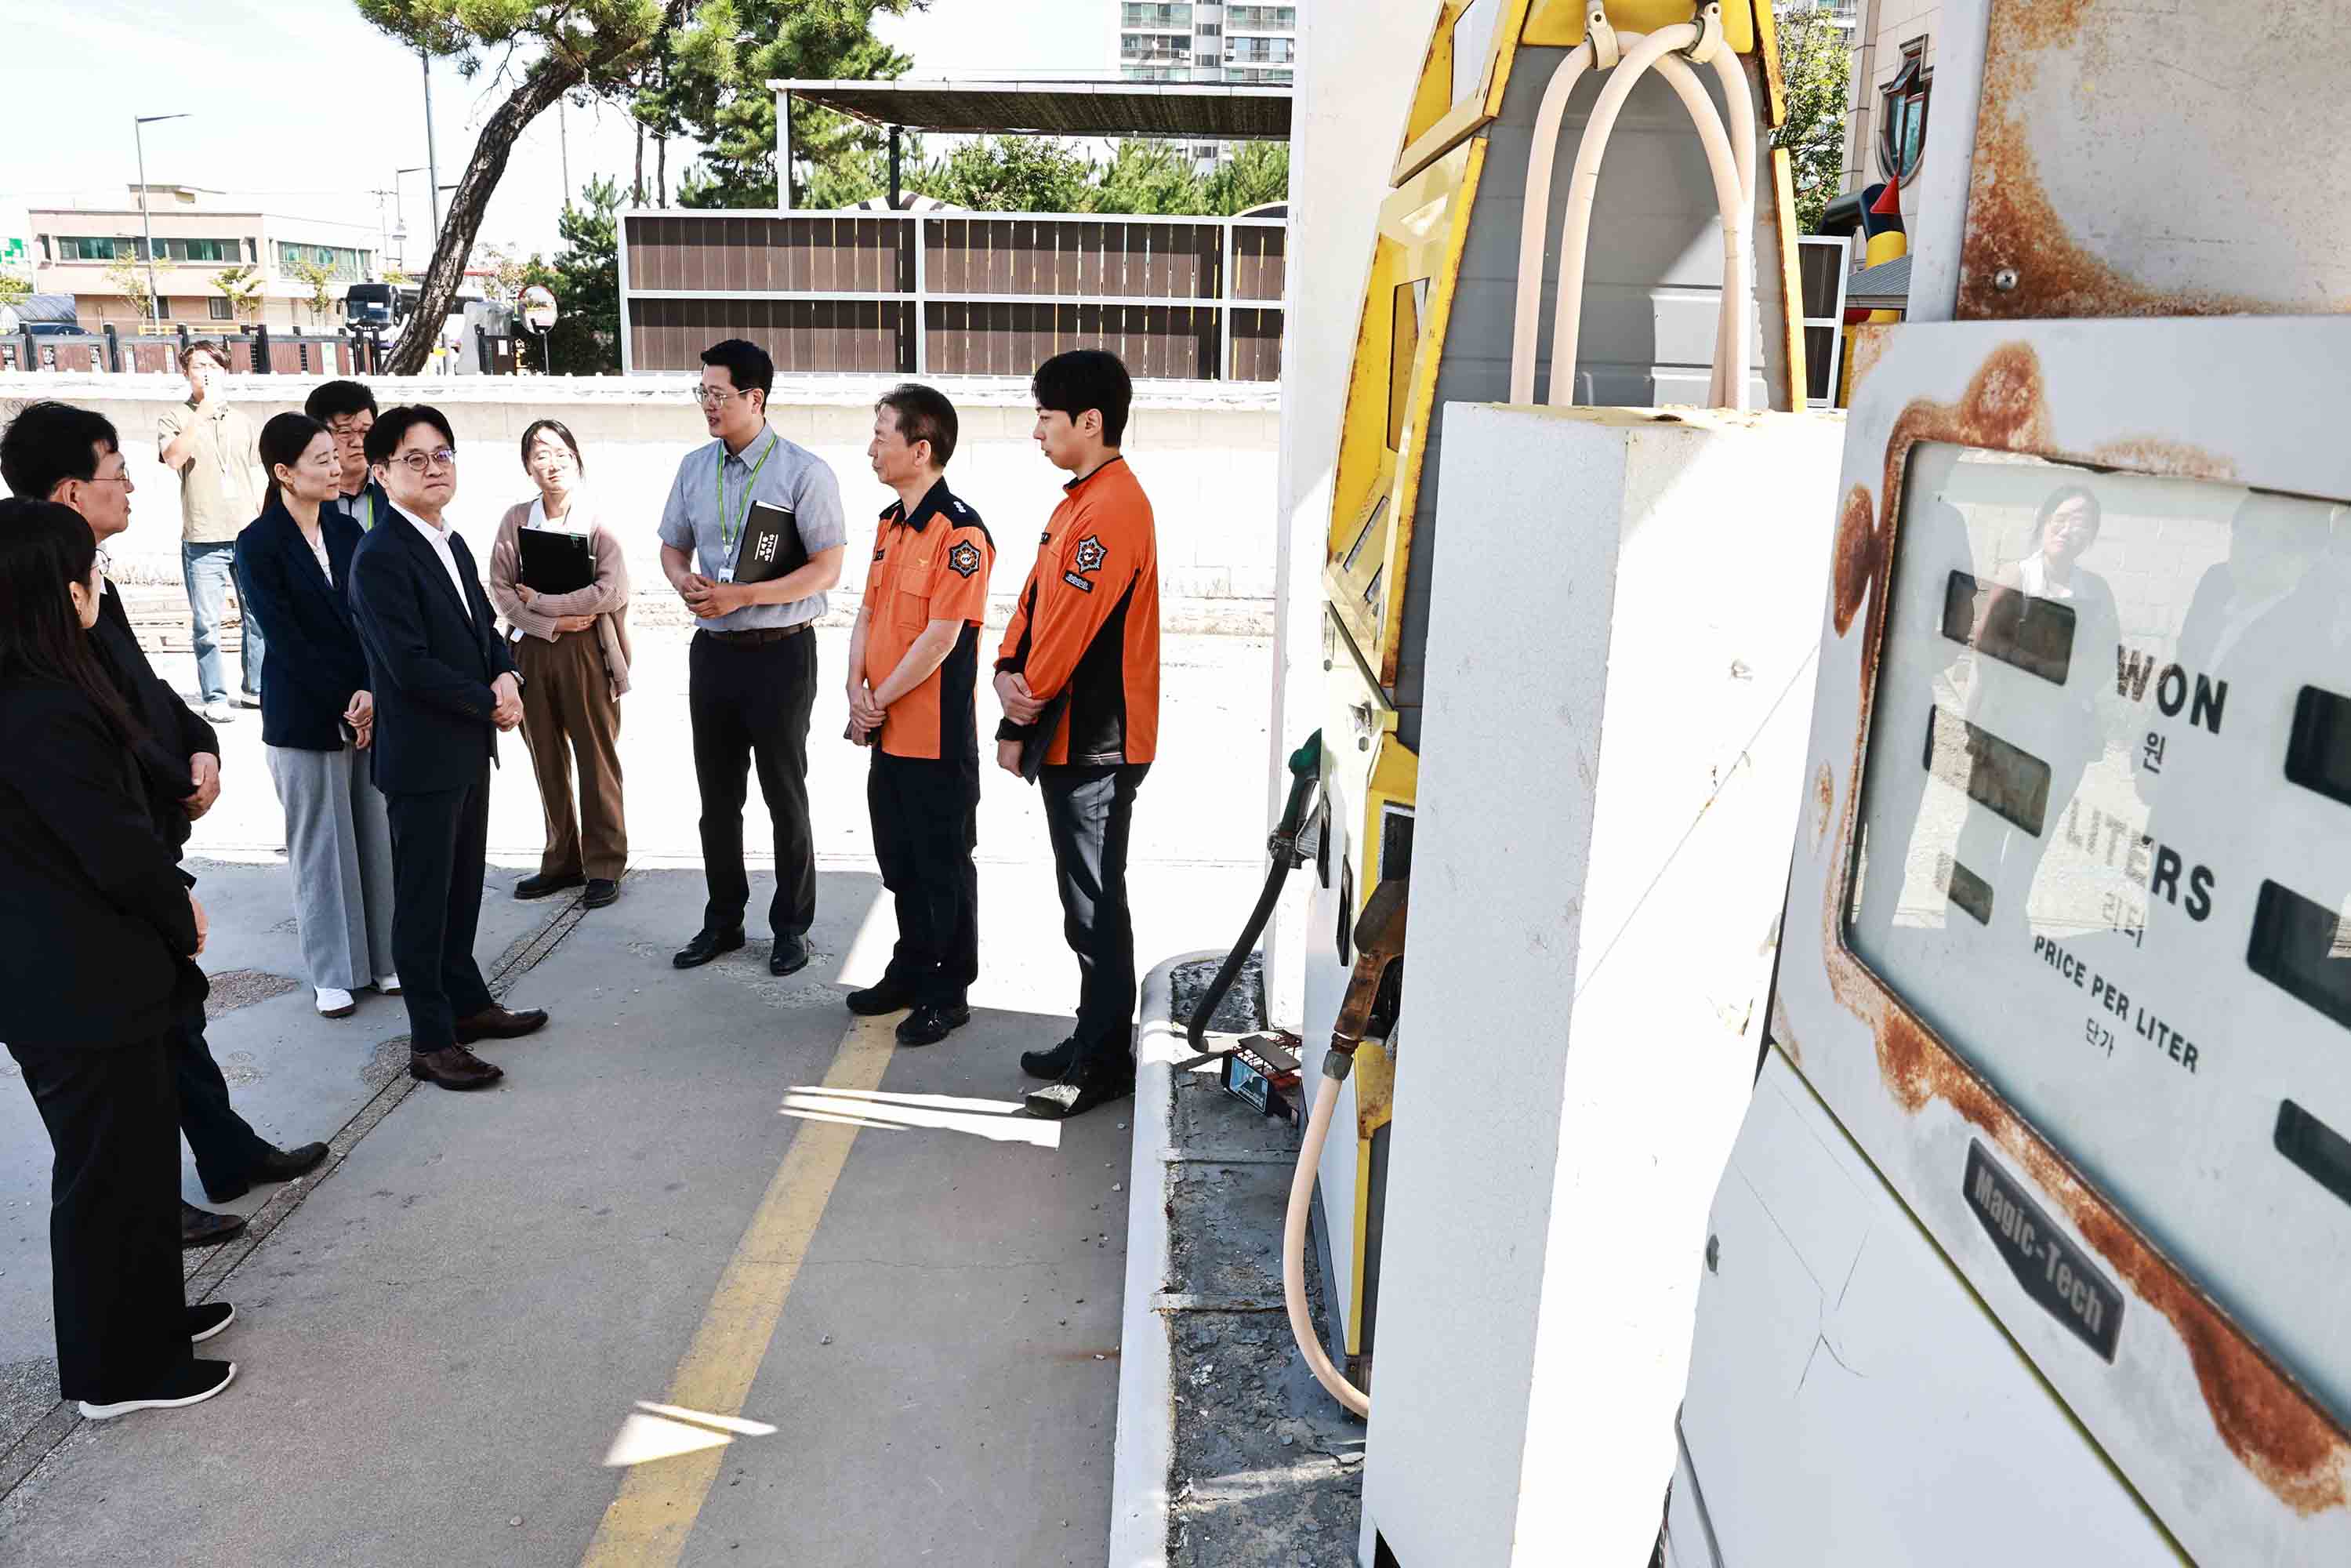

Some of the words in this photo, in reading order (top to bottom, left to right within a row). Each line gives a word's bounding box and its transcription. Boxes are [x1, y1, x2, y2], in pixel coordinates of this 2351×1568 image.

[2118, 644, 2228, 735] WON
[2144, 732, 2166, 775] 원
[2066, 797, 2215, 923] LITERS
[2102, 892, 2146, 948] 리터
[2034, 935, 2087, 989] PRICE
[2092, 974, 2130, 1022] PER
[2136, 1007, 2199, 1074] LITER
[2085, 1018, 2114, 1059] 단가
[1974, 1166, 2104, 1334] Magic-Tech
